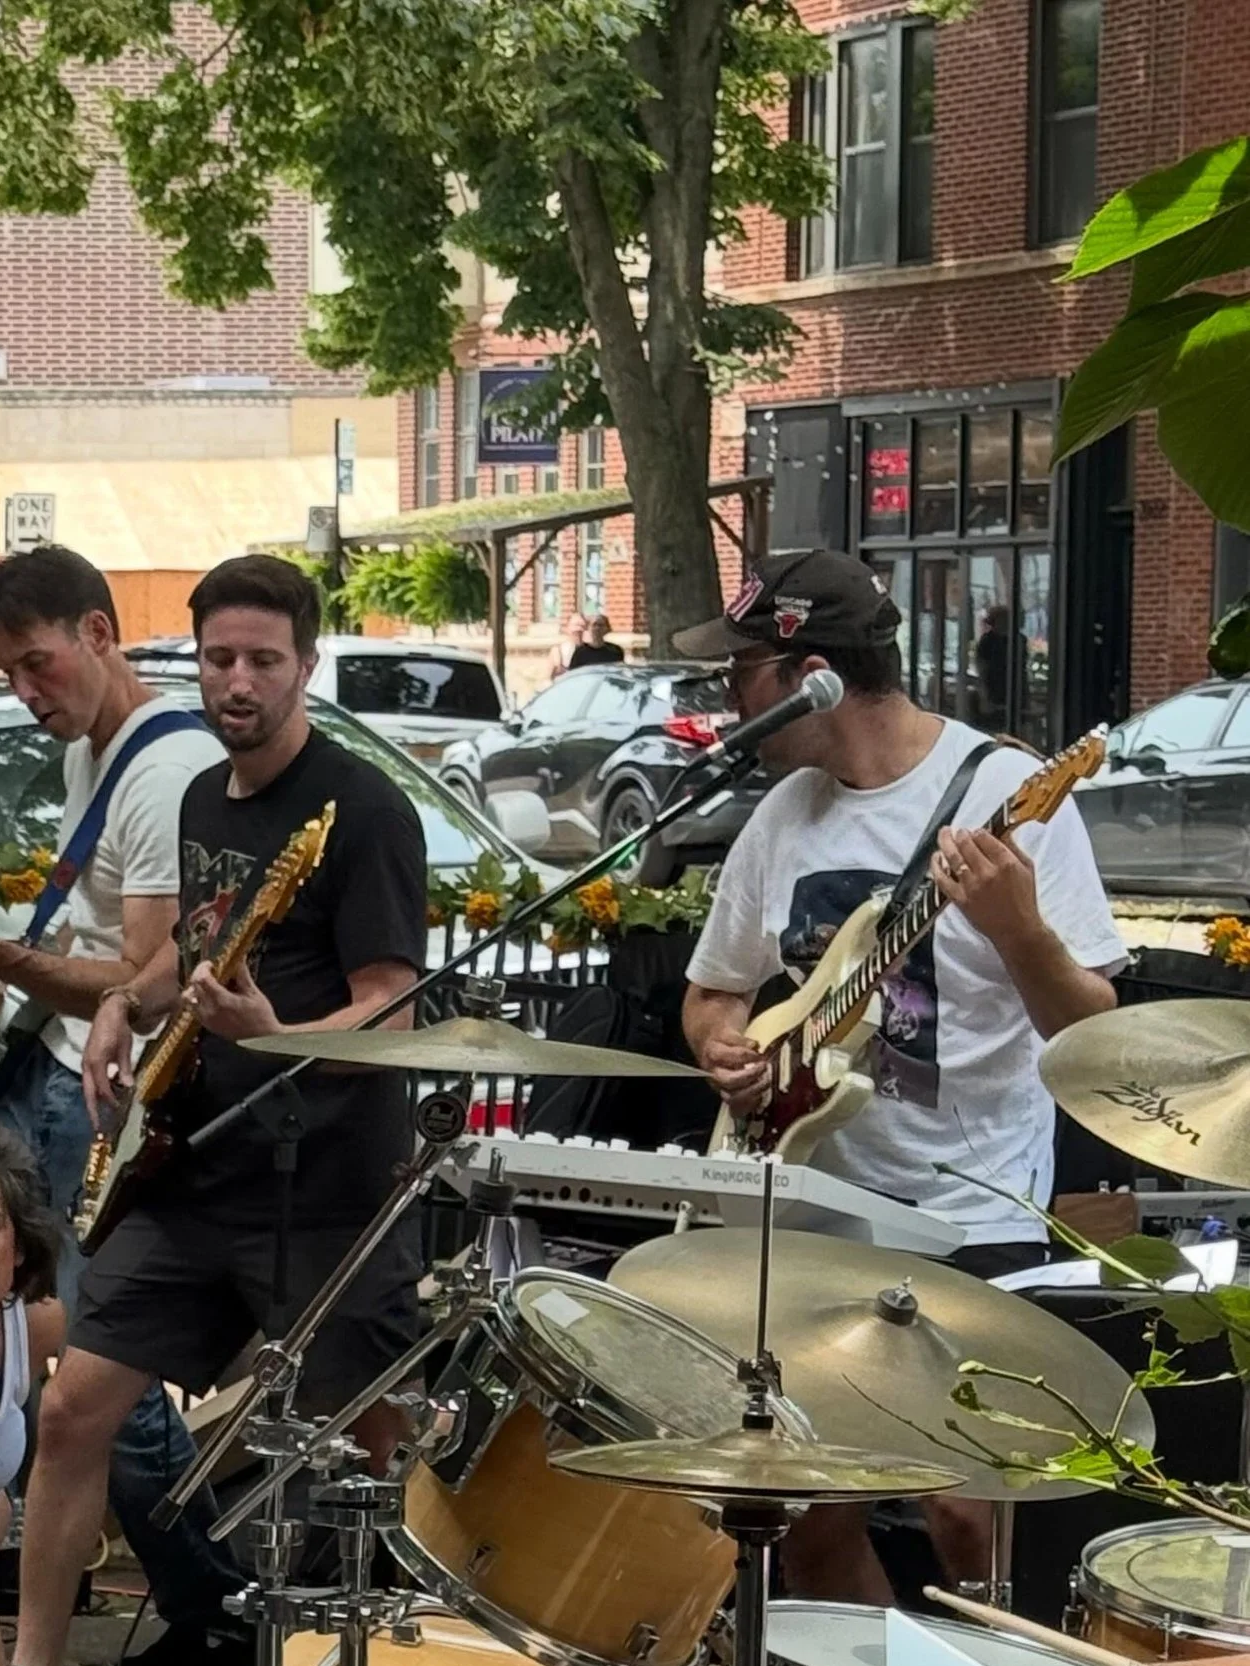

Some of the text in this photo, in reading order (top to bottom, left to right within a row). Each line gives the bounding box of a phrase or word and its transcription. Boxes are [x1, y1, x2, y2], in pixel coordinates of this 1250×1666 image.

[17, 498, 52, 512] ONE
[17, 515, 51, 531] WAY
[1092, 1081, 1201, 1146] Zildjian
[702, 1167, 790, 1188] KingKORG EO
